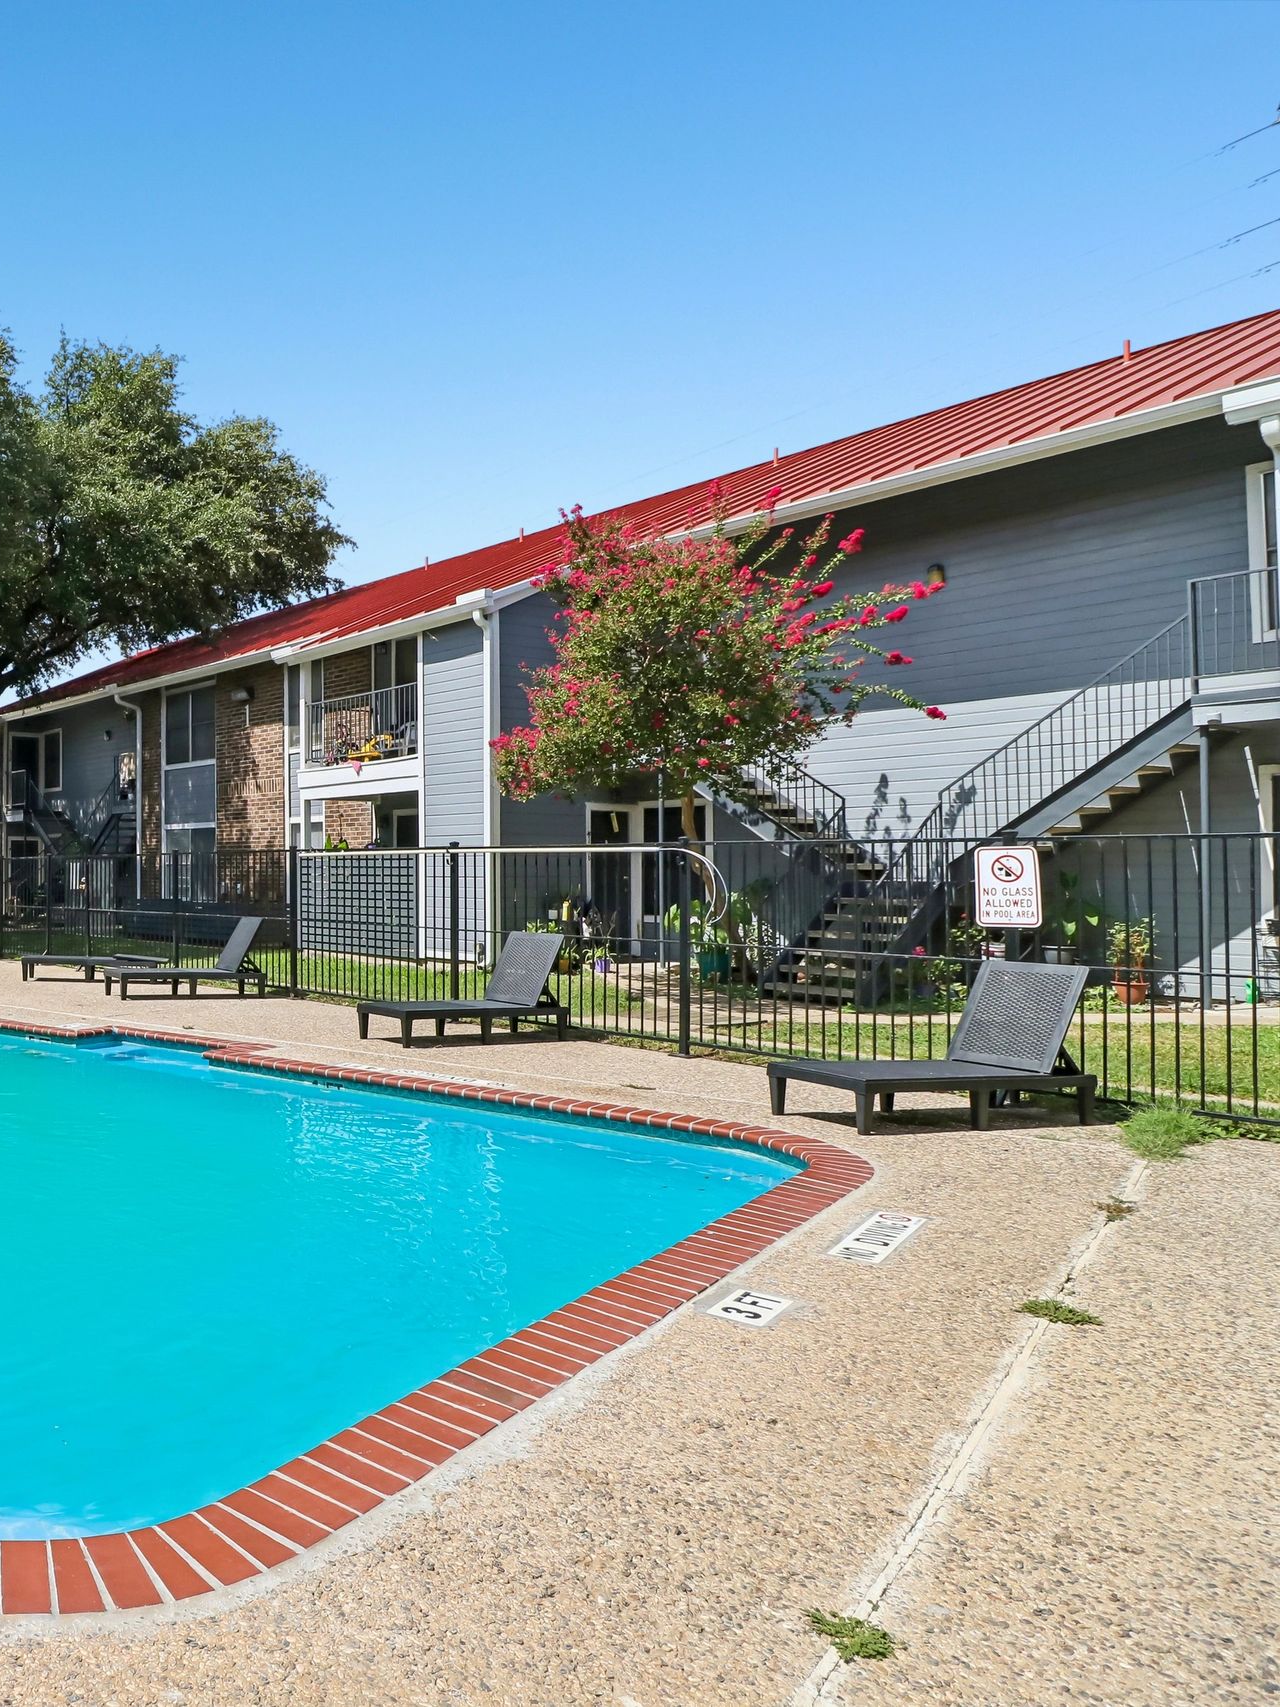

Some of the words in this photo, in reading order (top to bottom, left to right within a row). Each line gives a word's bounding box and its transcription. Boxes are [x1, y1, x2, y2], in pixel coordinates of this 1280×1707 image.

[983, 888, 997, 896] NO
[1002, 887, 1033, 897] GLASS
[985, 899, 1032, 908] ALLOWED
[982, 910, 990, 918] IN
[994, 910, 1013, 918] POOL
[1017, 910, 1035, 918] AREA
[853, 1220, 910, 1247] DIVING
[835, 1247, 879, 1261] NO
[737, 1291, 783, 1311] FT
[721, 1306, 763, 1320] 3
